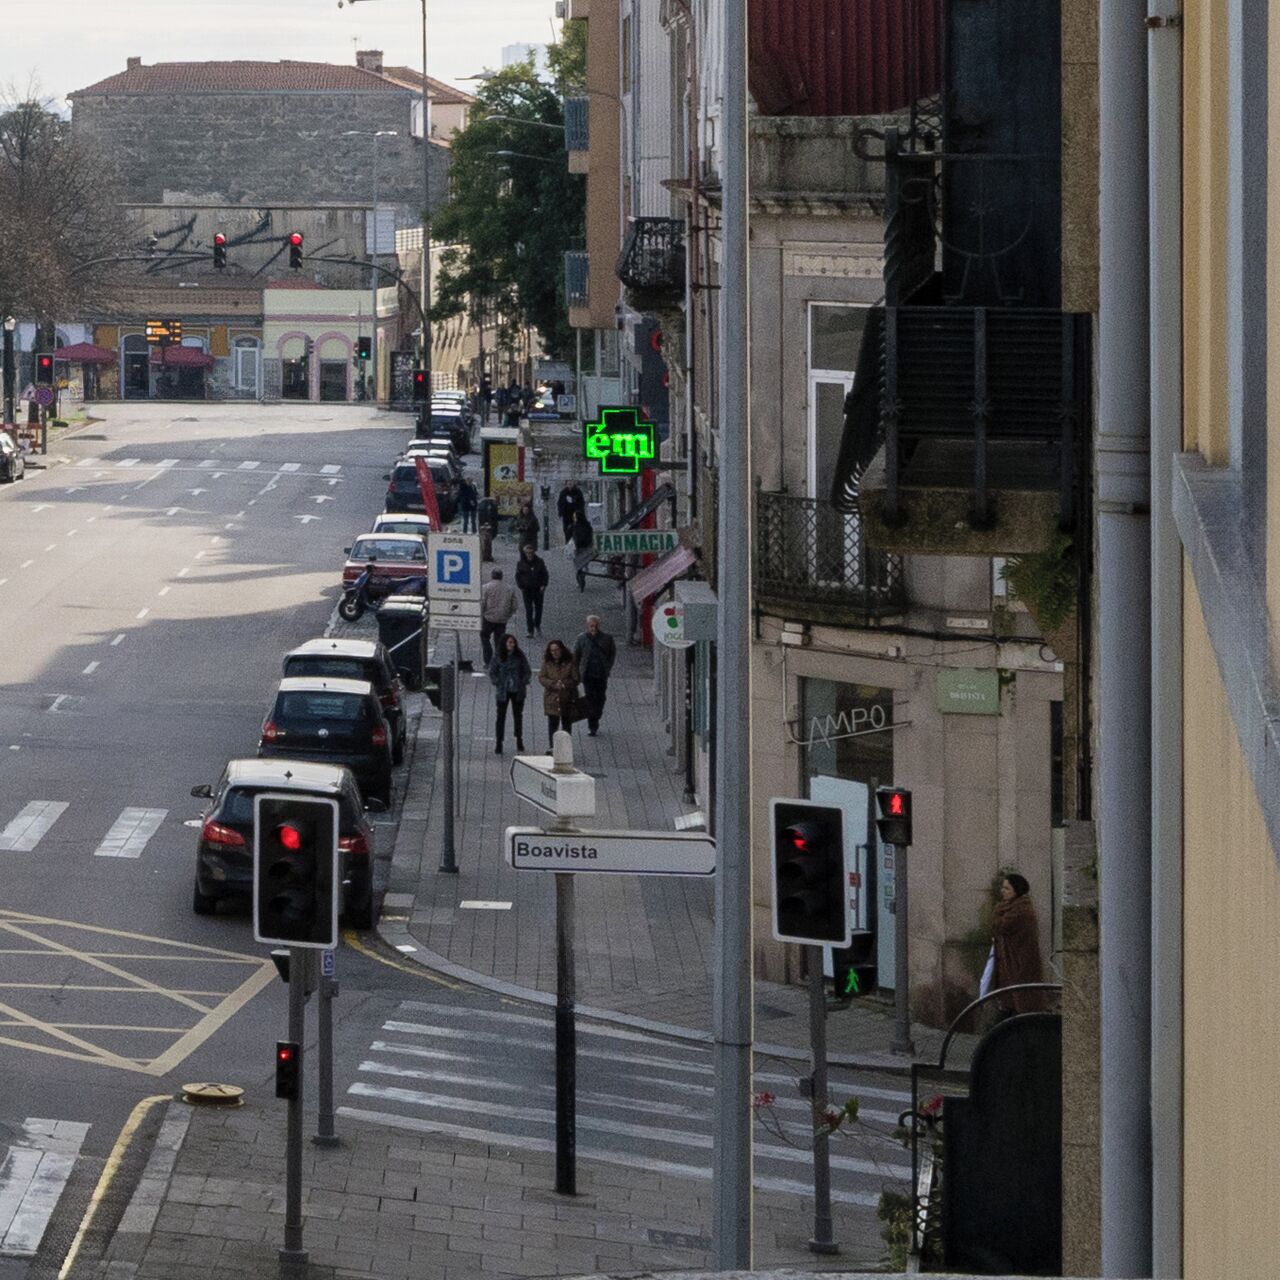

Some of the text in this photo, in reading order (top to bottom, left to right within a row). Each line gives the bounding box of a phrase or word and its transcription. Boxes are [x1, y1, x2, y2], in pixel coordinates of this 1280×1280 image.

[596, 534, 675, 552] FARMACIA
[443, 554, 464, 581] P
[517, 842, 598, 859] Boavista
